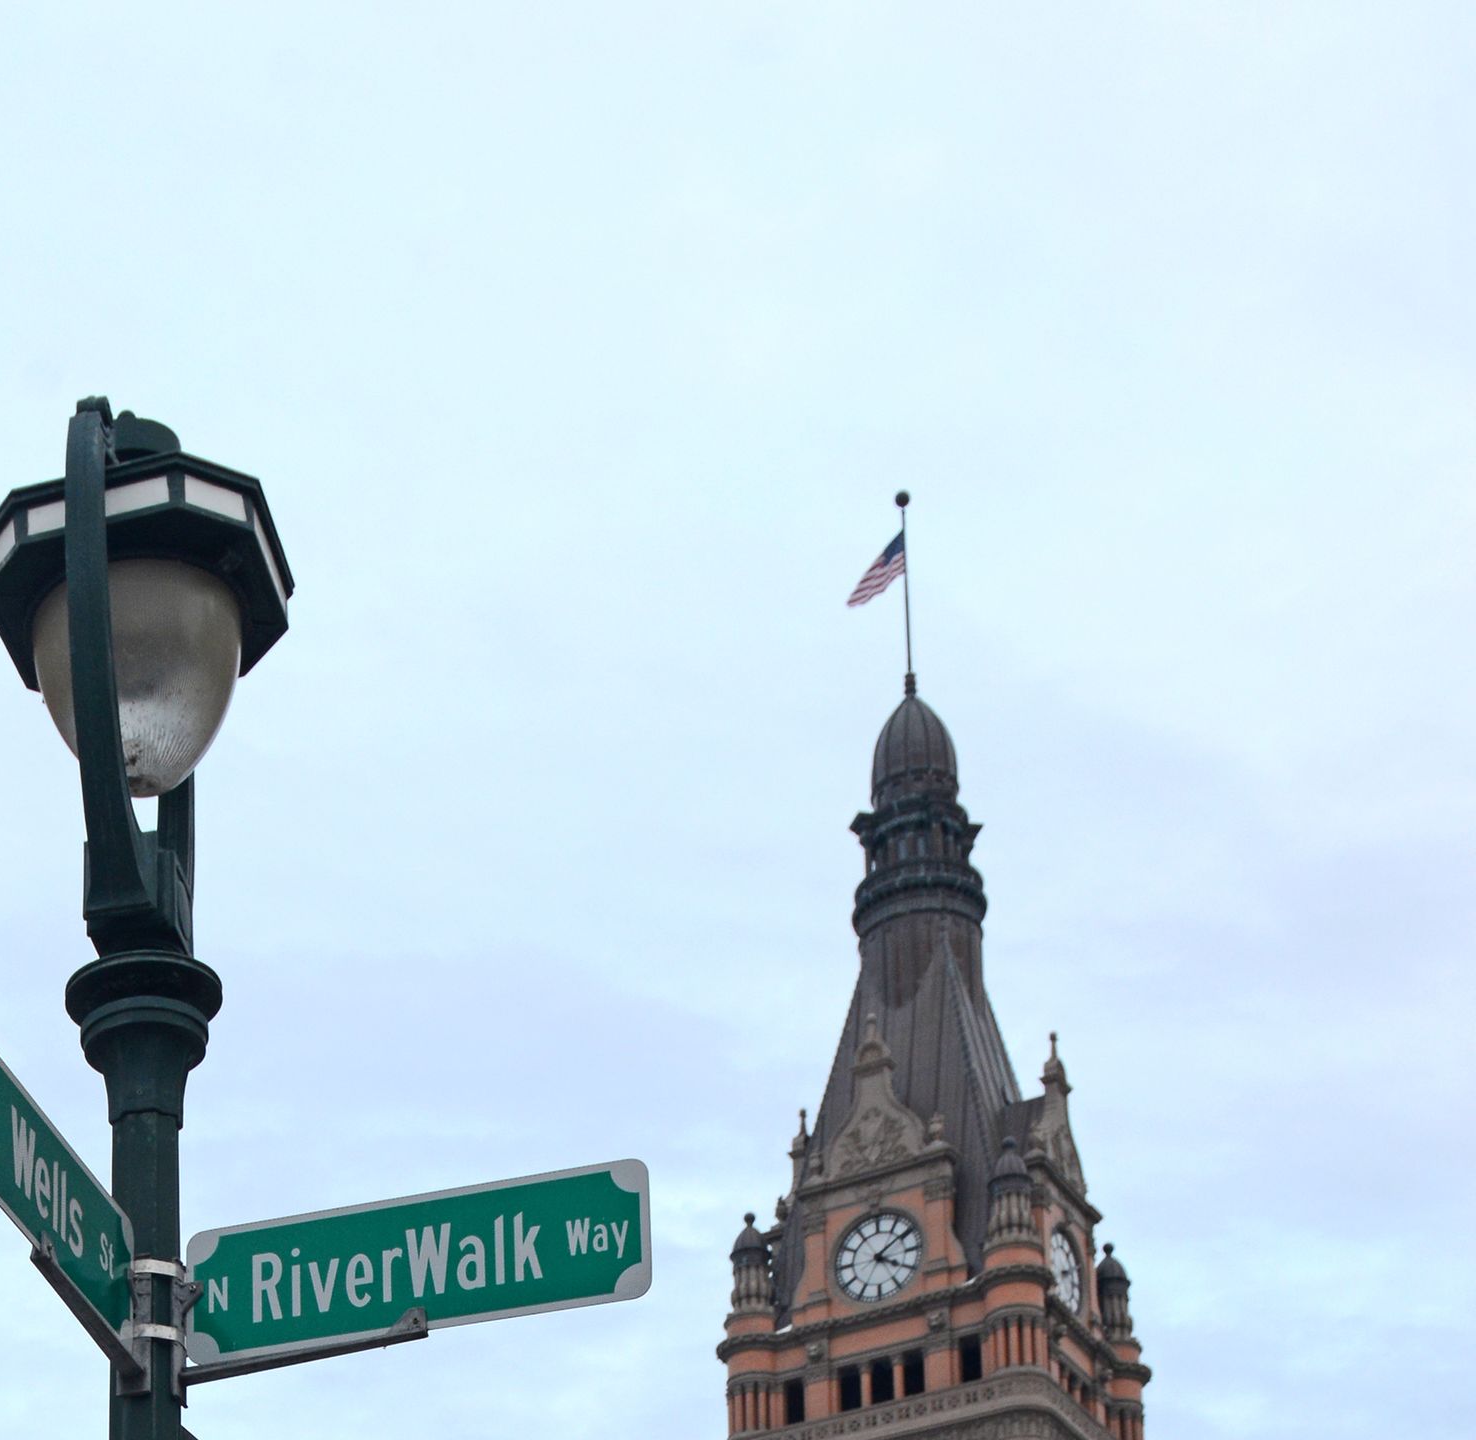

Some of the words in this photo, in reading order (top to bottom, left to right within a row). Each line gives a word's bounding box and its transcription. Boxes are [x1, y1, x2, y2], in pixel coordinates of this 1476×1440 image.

[11, 1104, 84, 1258] Wells
[99, 1232, 115, 1280] St
[207, 1276, 229, 1315] N
[251, 1211, 544, 1324] RiverWalk
[565, 1216, 630, 1260] Way
